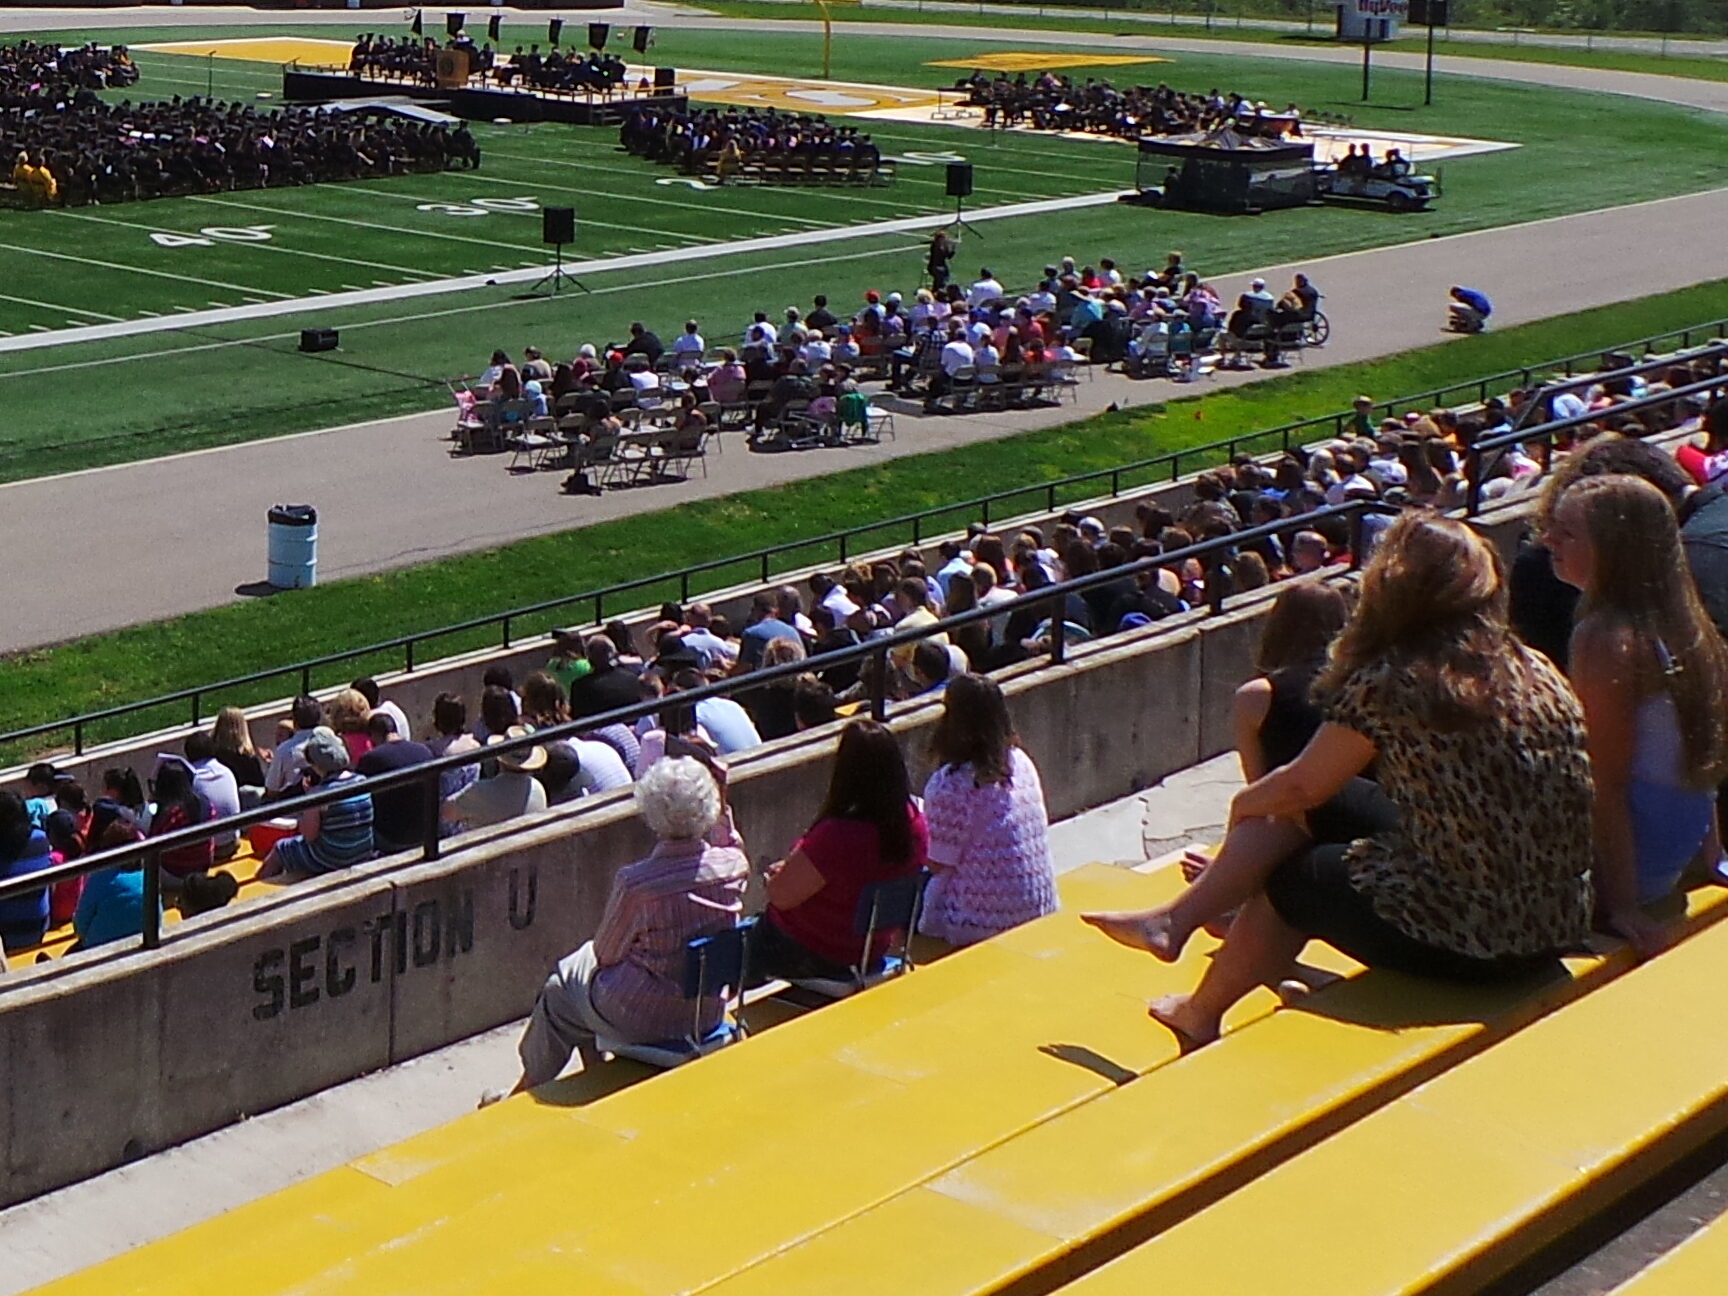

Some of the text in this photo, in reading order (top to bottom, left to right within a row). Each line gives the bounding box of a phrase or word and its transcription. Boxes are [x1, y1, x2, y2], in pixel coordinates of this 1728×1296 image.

[149, 227, 272, 246] 40
[252, 866, 538, 1021] SECTION U
